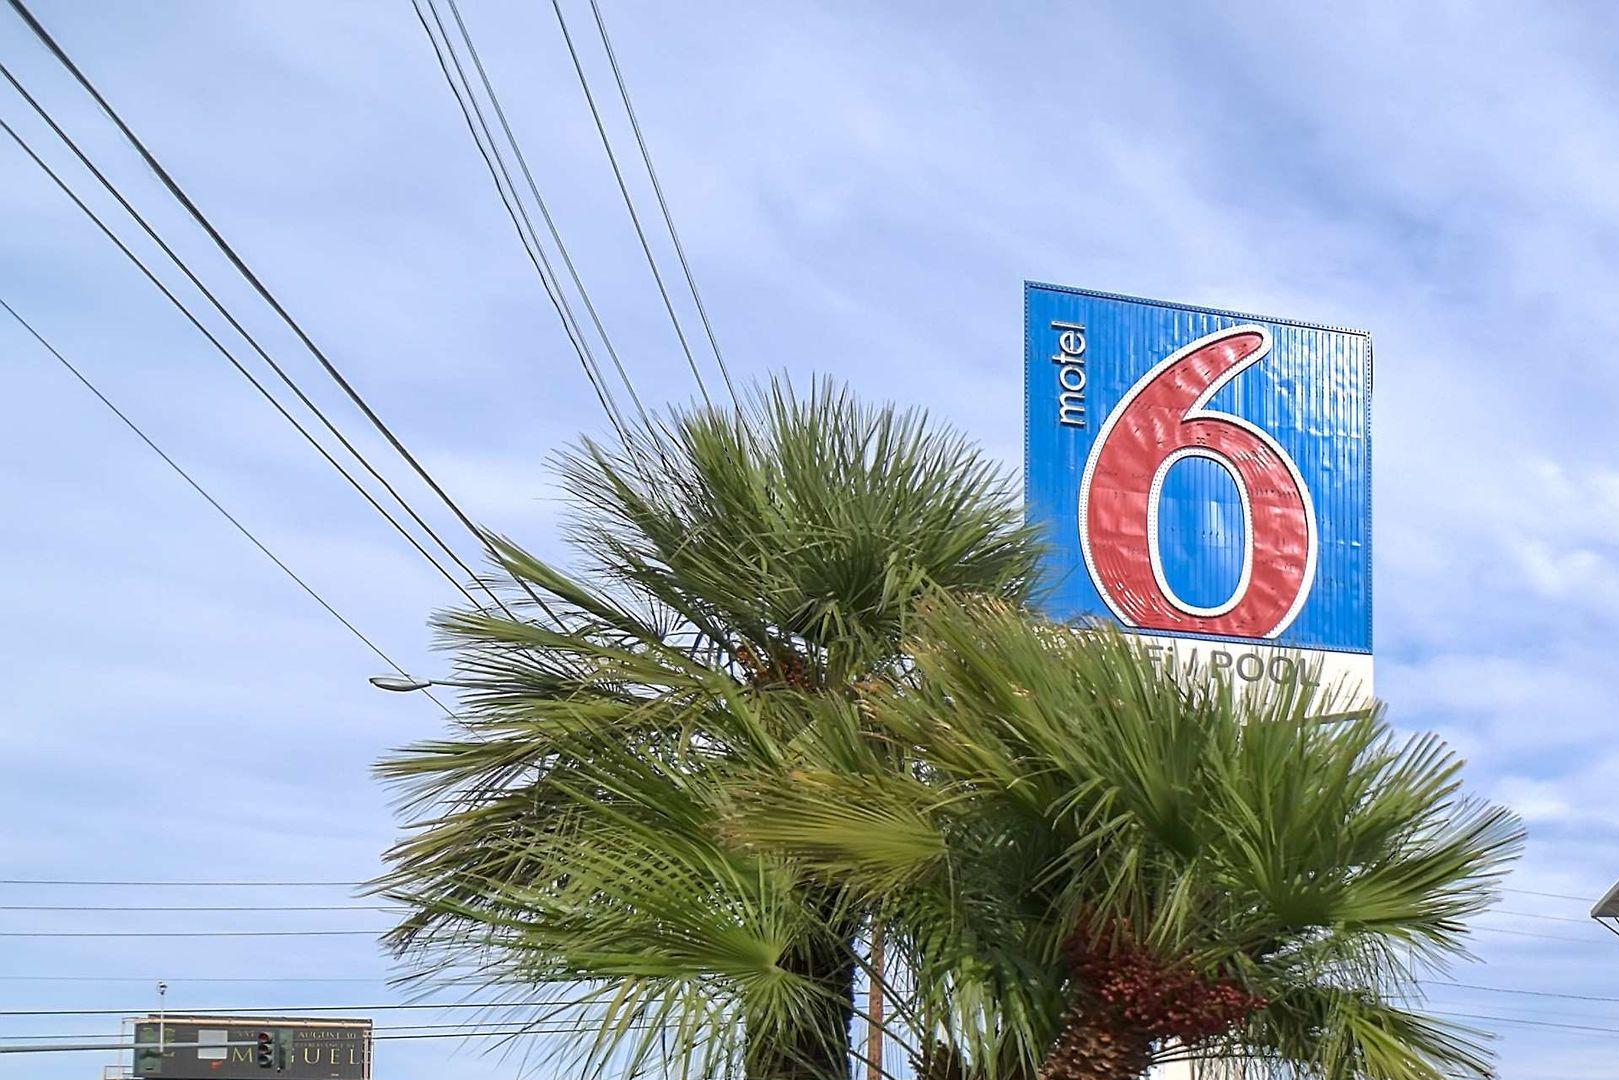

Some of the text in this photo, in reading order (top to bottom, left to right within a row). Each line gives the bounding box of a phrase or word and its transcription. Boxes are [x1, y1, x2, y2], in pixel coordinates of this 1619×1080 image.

[1051, 320, 1318, 639] motel 6
[1210, 649, 1320, 687] POOL
